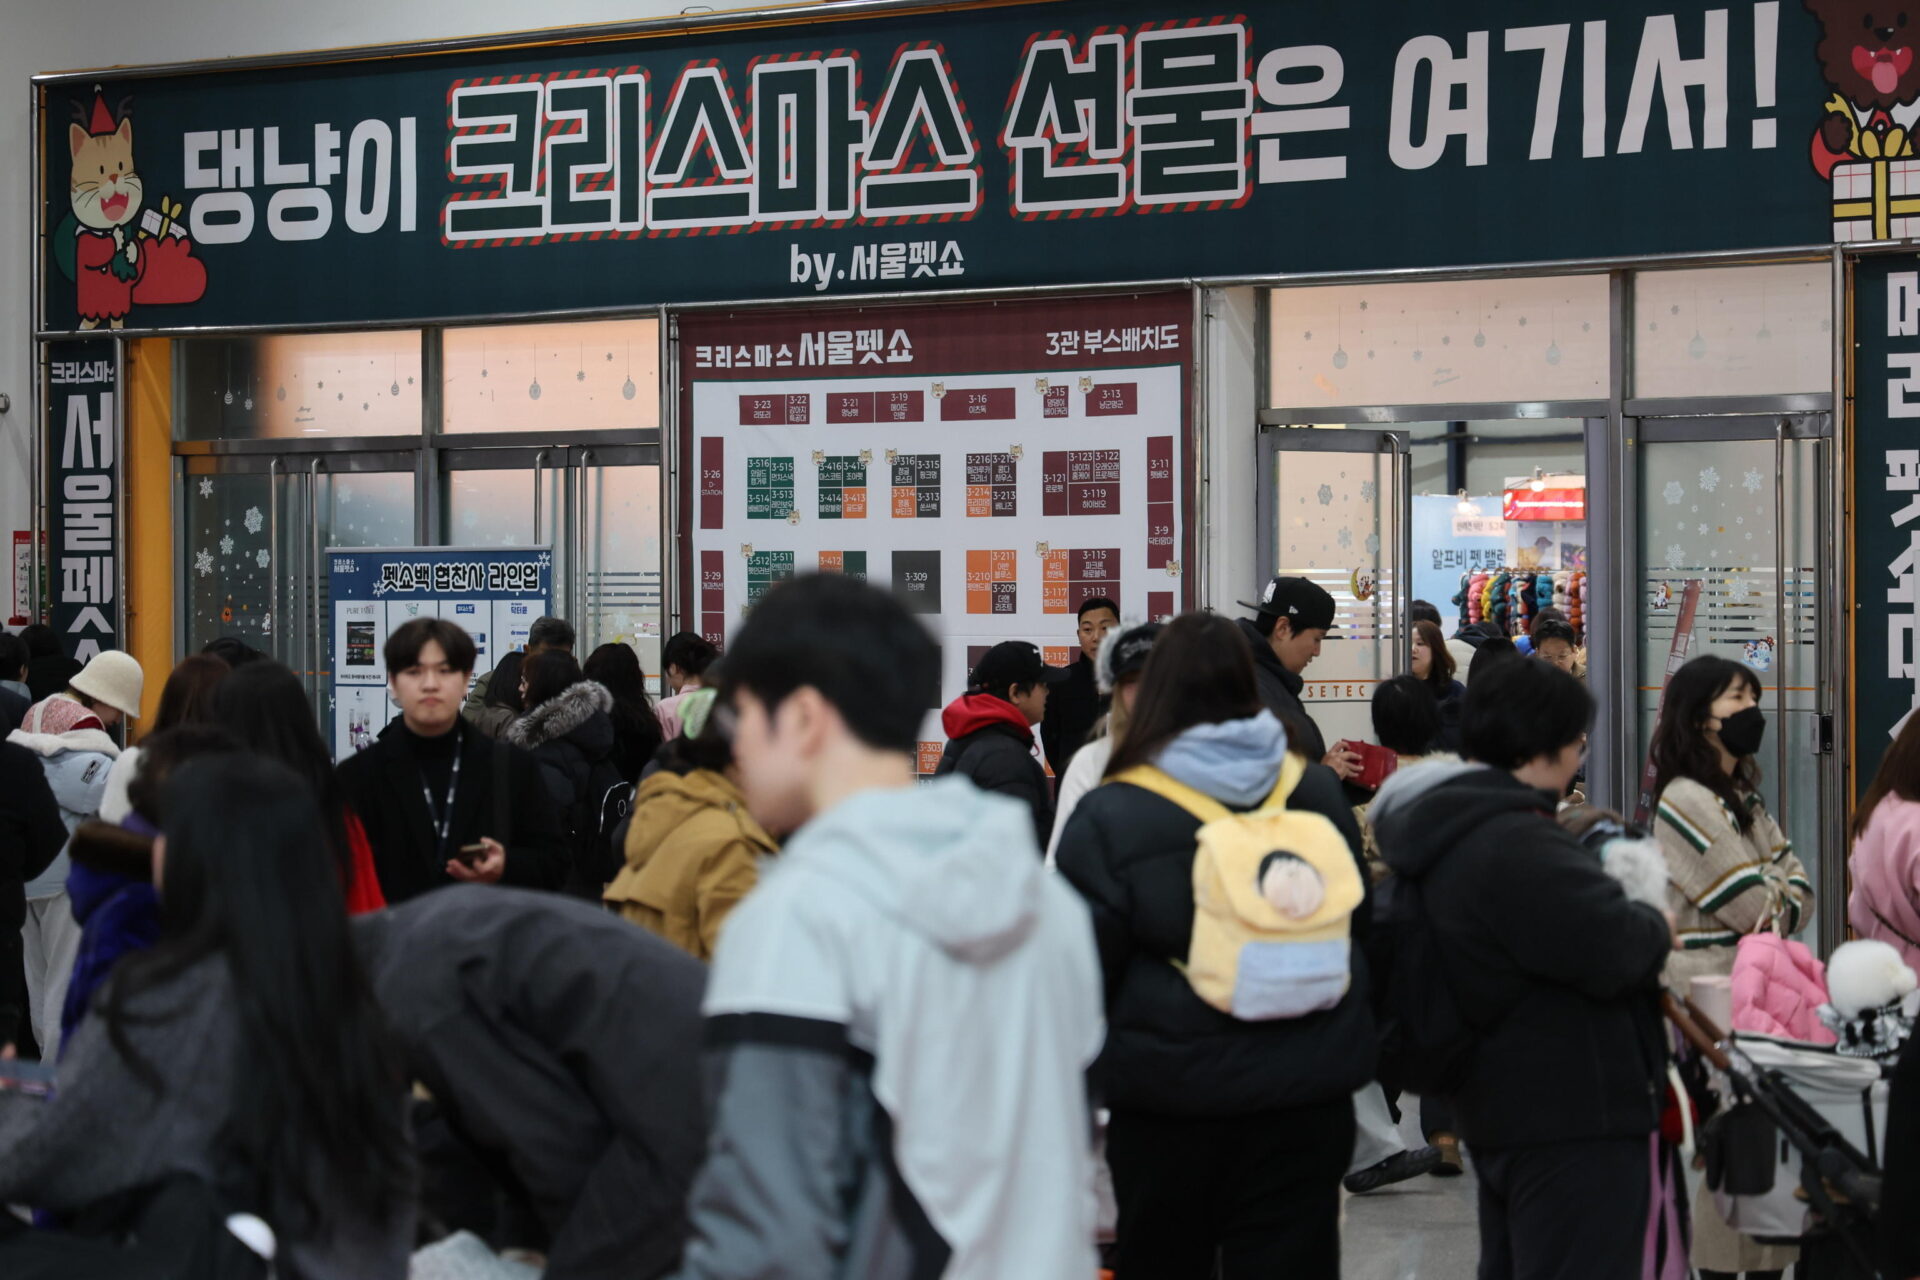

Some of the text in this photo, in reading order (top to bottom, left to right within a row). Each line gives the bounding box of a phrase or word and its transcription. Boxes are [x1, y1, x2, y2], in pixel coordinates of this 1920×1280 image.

[183, 1, 1780, 245] 댕냥이 크리스마스 선물은 여기서!
[1045, 323, 1180, 356] 3관 부스배치도
[695, 328, 914, 368] 크리스마스 서울펫쇼
[890, 393, 908, 402] 3-19
[1102, 389, 1121, 399] 3-13
[789, 396, 807, 405] 3-22
[842, 398, 859, 408] 3-21
[968, 395, 987, 404] 3-16
[754, 401, 771, 409] 3-23
[893, 456, 915, 465] 3-316
[967, 455, 991, 464] 3-216
[992, 454, 1016, 464] 3-215
[1069, 452, 1093, 461] 3-123
[1095, 451, 1119, 461] 3-122
[748, 459, 769, 468] 3-516
[771, 463, 793, 471] 3-515
[819, 462, 842, 470] 3-416
[843, 461, 866, 470] 3-415
[917, 460, 939, 469] 3-315
[1151, 459, 1169, 468] 3-11
[703, 470, 720, 478] 3-26
[1043, 473, 1066, 483] 3-121
[771, 490, 793, 499] 3-513
[893, 488, 915, 497] 3-314
[967, 487, 990, 496] 3-214
[993, 491, 1016, 500] 3-213
[1082, 489, 1107, 498] 3-119
[748, 494, 770, 502] 3-514
[819, 494, 842, 503] 3-414
[843, 494, 866, 502] 3-413
[917, 492, 939, 501] 3-313
[1154, 526, 1169, 535] 3-9
[771, 552, 793, 561] 3-511
[992, 551, 1015, 560] 3-211
[1082, 550, 1107, 559] 3-115
[748, 556, 770, 565] 3-512
[819, 556, 842, 566] 3-412
[1432, 549, 1467, 570] 알프비
[1470, 549, 1482, 570] 펫
[382, 561, 539, 591] 펫쇼백 협찬사 라인업
[704, 571, 721, 580] 3-29
[904, 572, 927, 581] 3-309
[967, 572, 990, 581] 3-210
[992, 583, 1016, 593] 3-209
[1043, 588, 1068, 597] 3-117
[1082, 587, 1107, 597] 3-113
[706, 633, 722, 642] 3-31
[1043, 652, 1068, 661] 3-112
[1307, 685, 1365, 698] SETEC
[919, 743, 942, 752] 3-303
